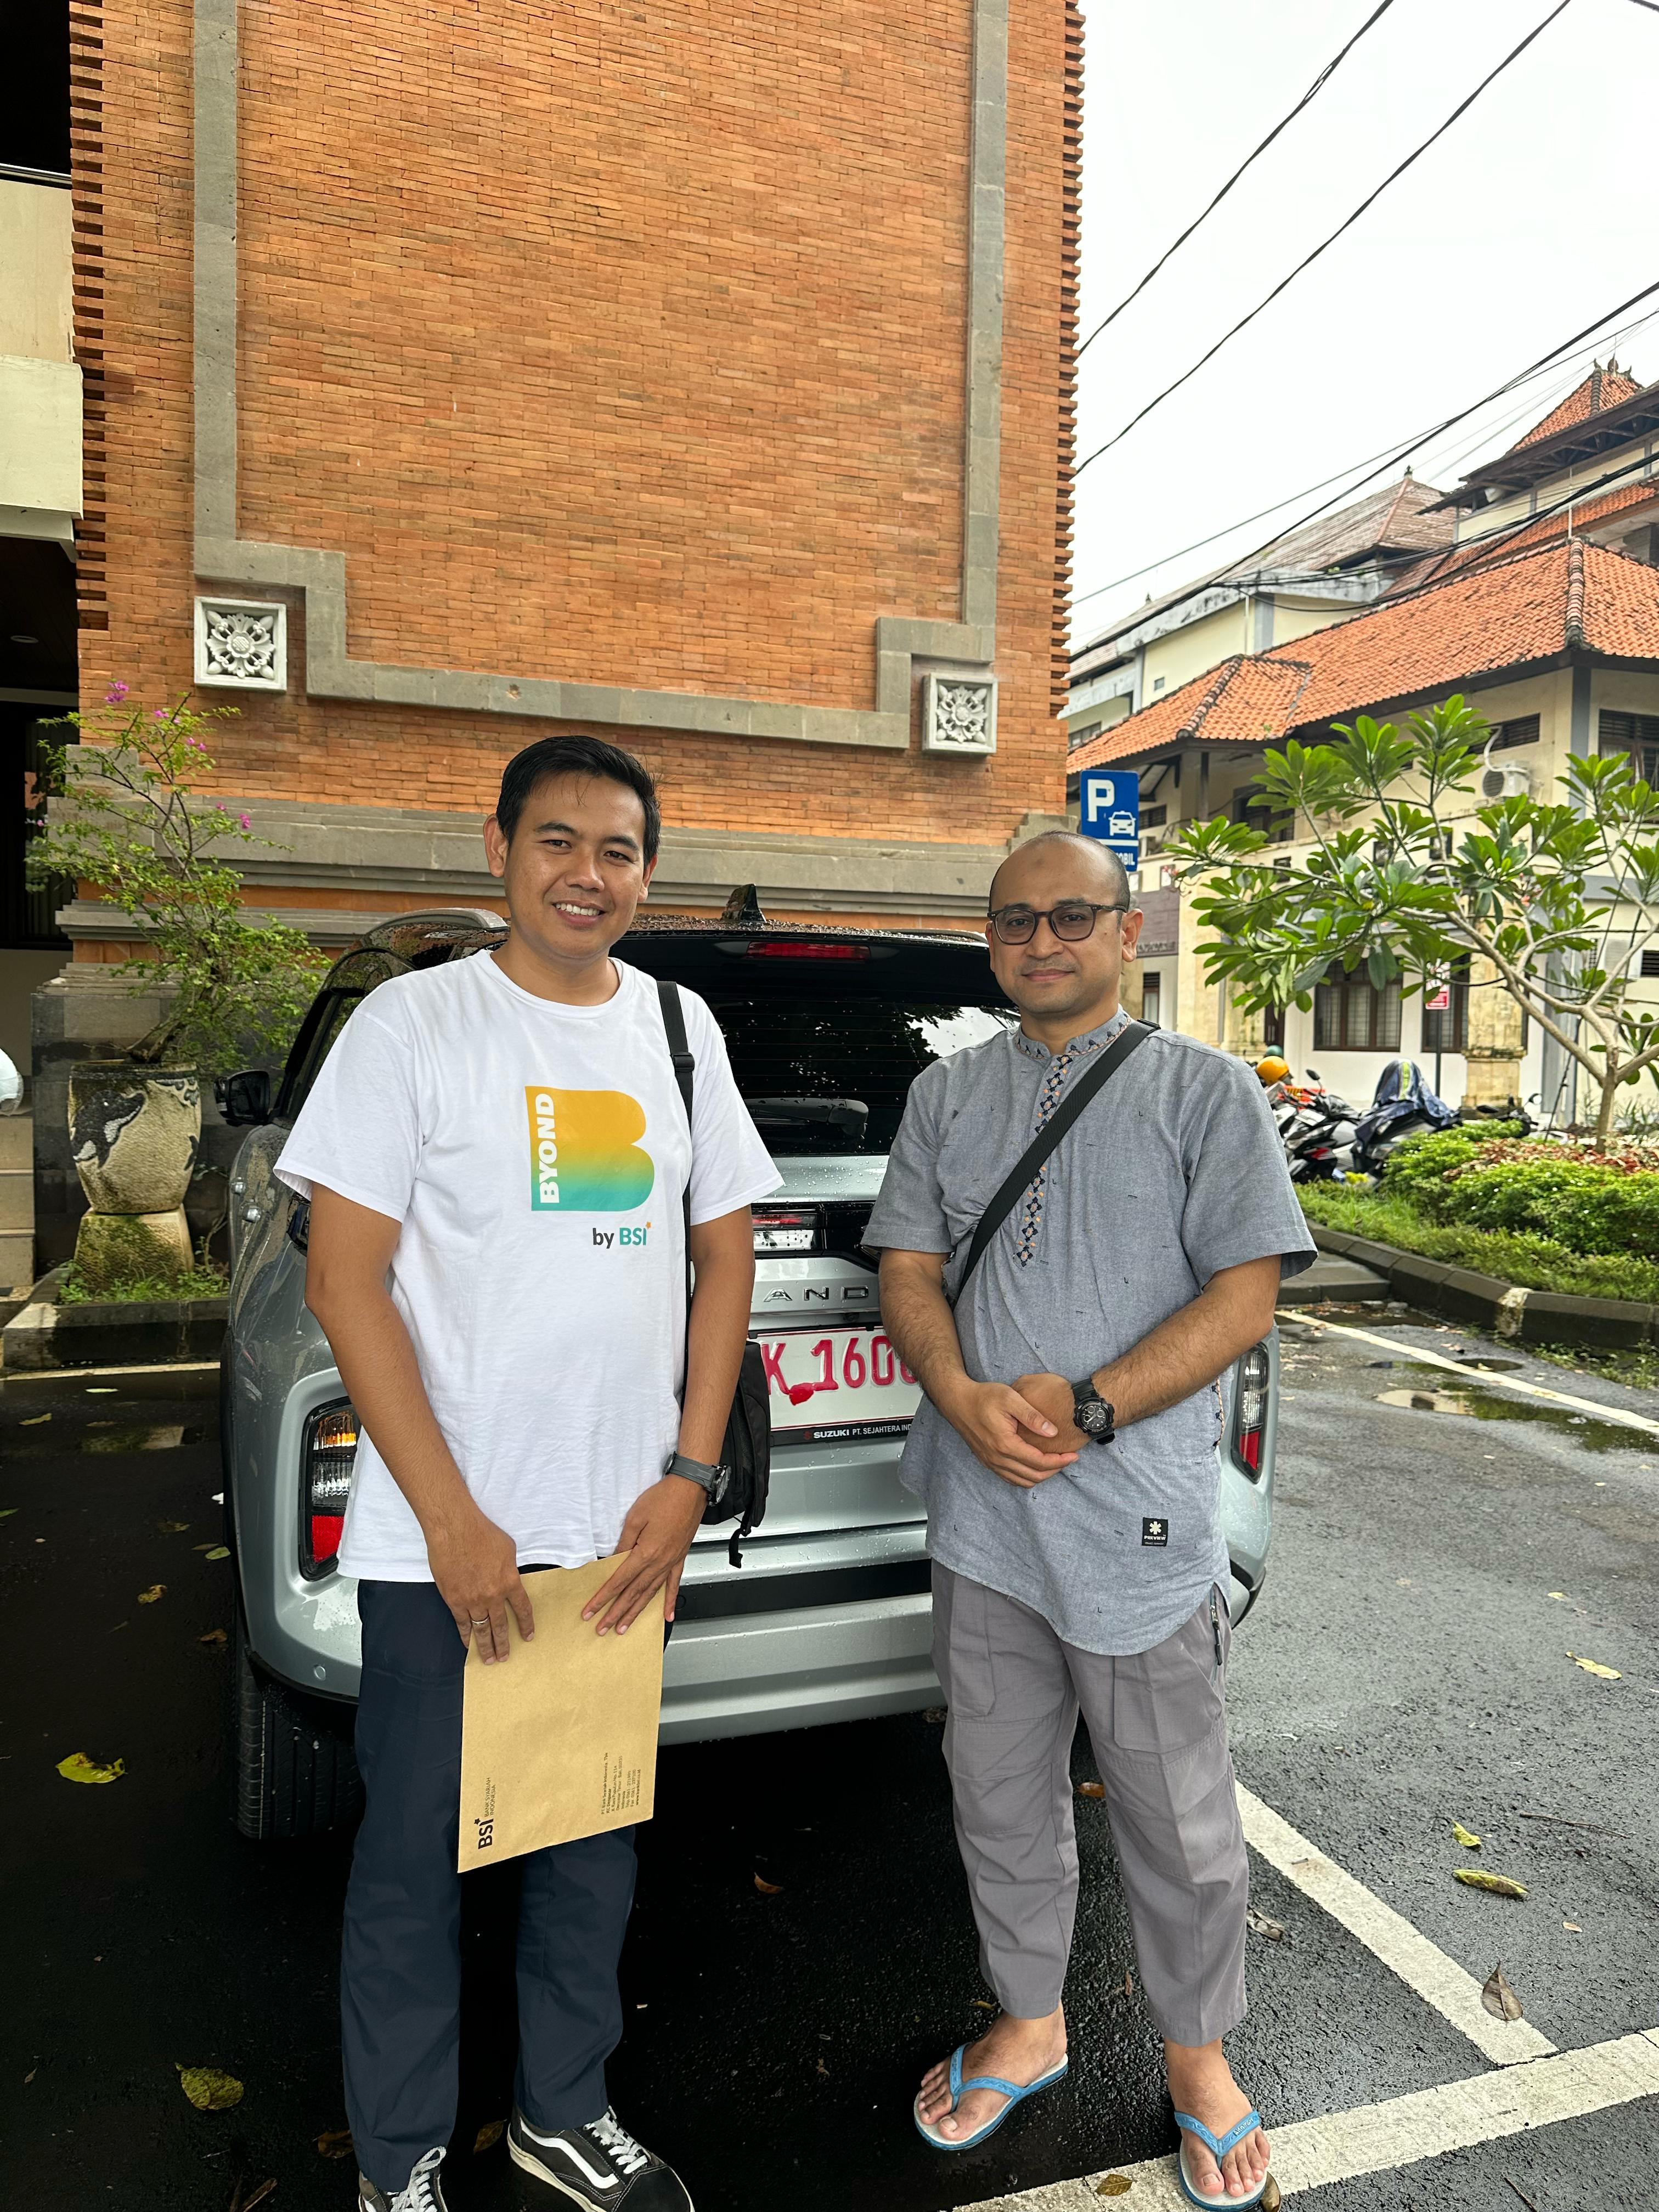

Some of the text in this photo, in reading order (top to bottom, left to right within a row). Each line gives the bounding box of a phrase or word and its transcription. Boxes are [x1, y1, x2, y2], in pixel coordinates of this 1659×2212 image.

[1087, 779, 1115, 822] P
[535, 1093, 560, 1203] BYOND
[592, 1225, 650, 1249] by BSI
[813, 1429, 849, 1438] SUZUKI
[863, 1425, 900, 1435] SEJAHTERA
[477, 1818, 494, 1849] BSI
